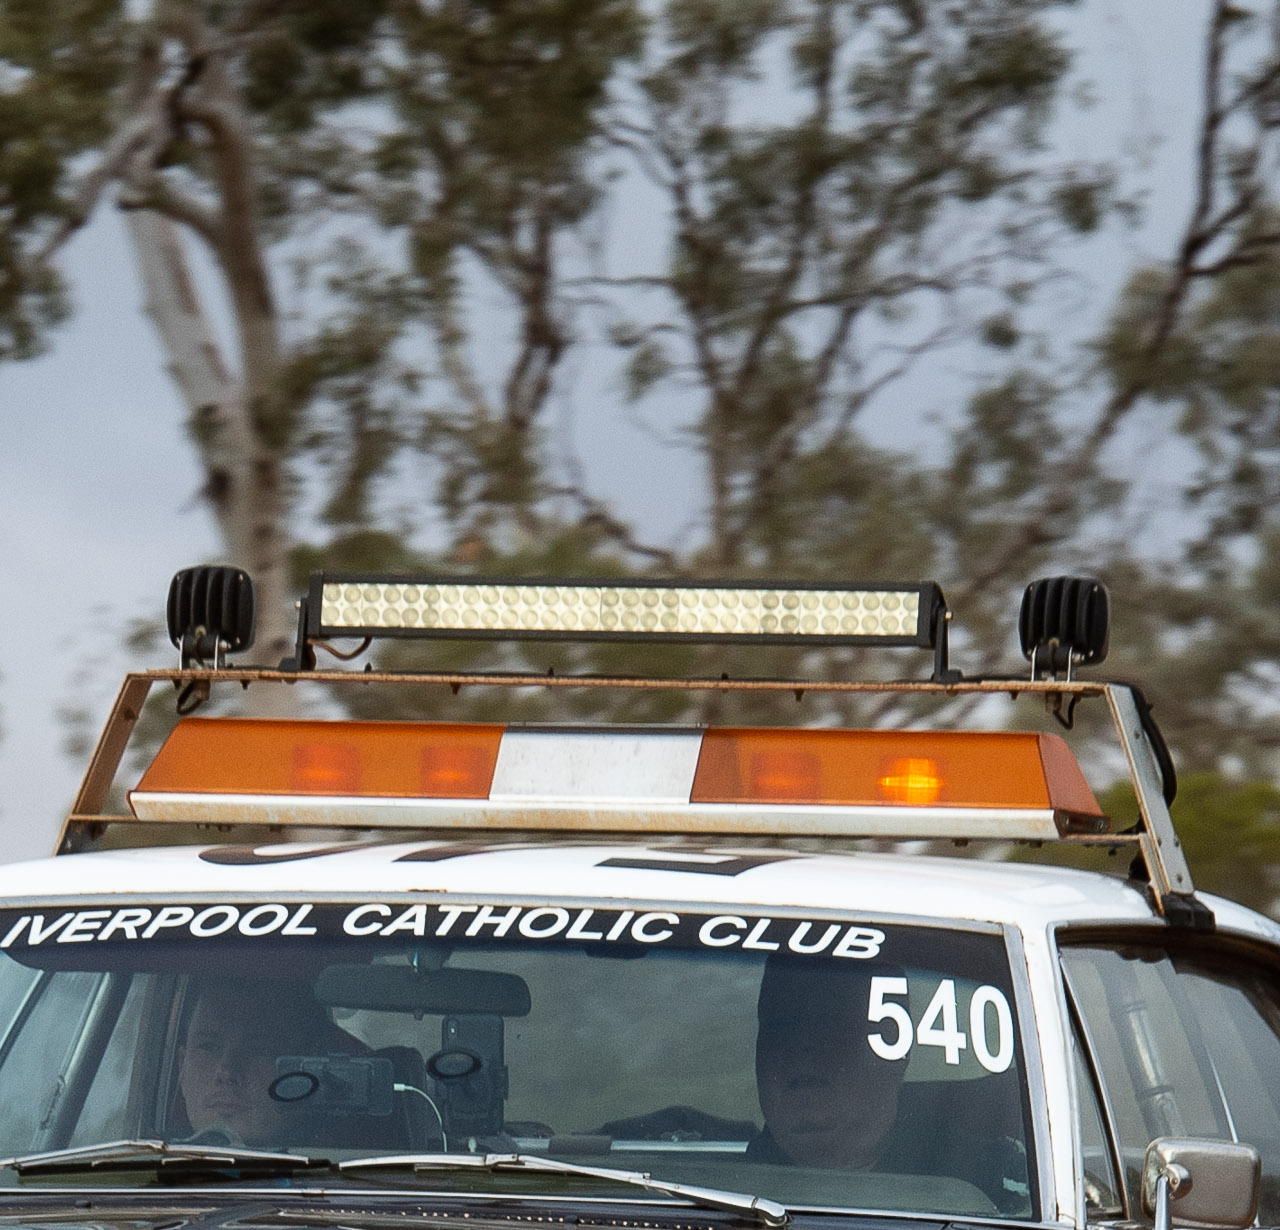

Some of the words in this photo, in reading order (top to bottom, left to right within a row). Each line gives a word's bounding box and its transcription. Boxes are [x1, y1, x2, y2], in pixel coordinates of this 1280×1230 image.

[342, 903, 680, 943] CATHOLIC
[698, 915, 887, 960] CLUB
[866, 975, 1015, 1074] 540
